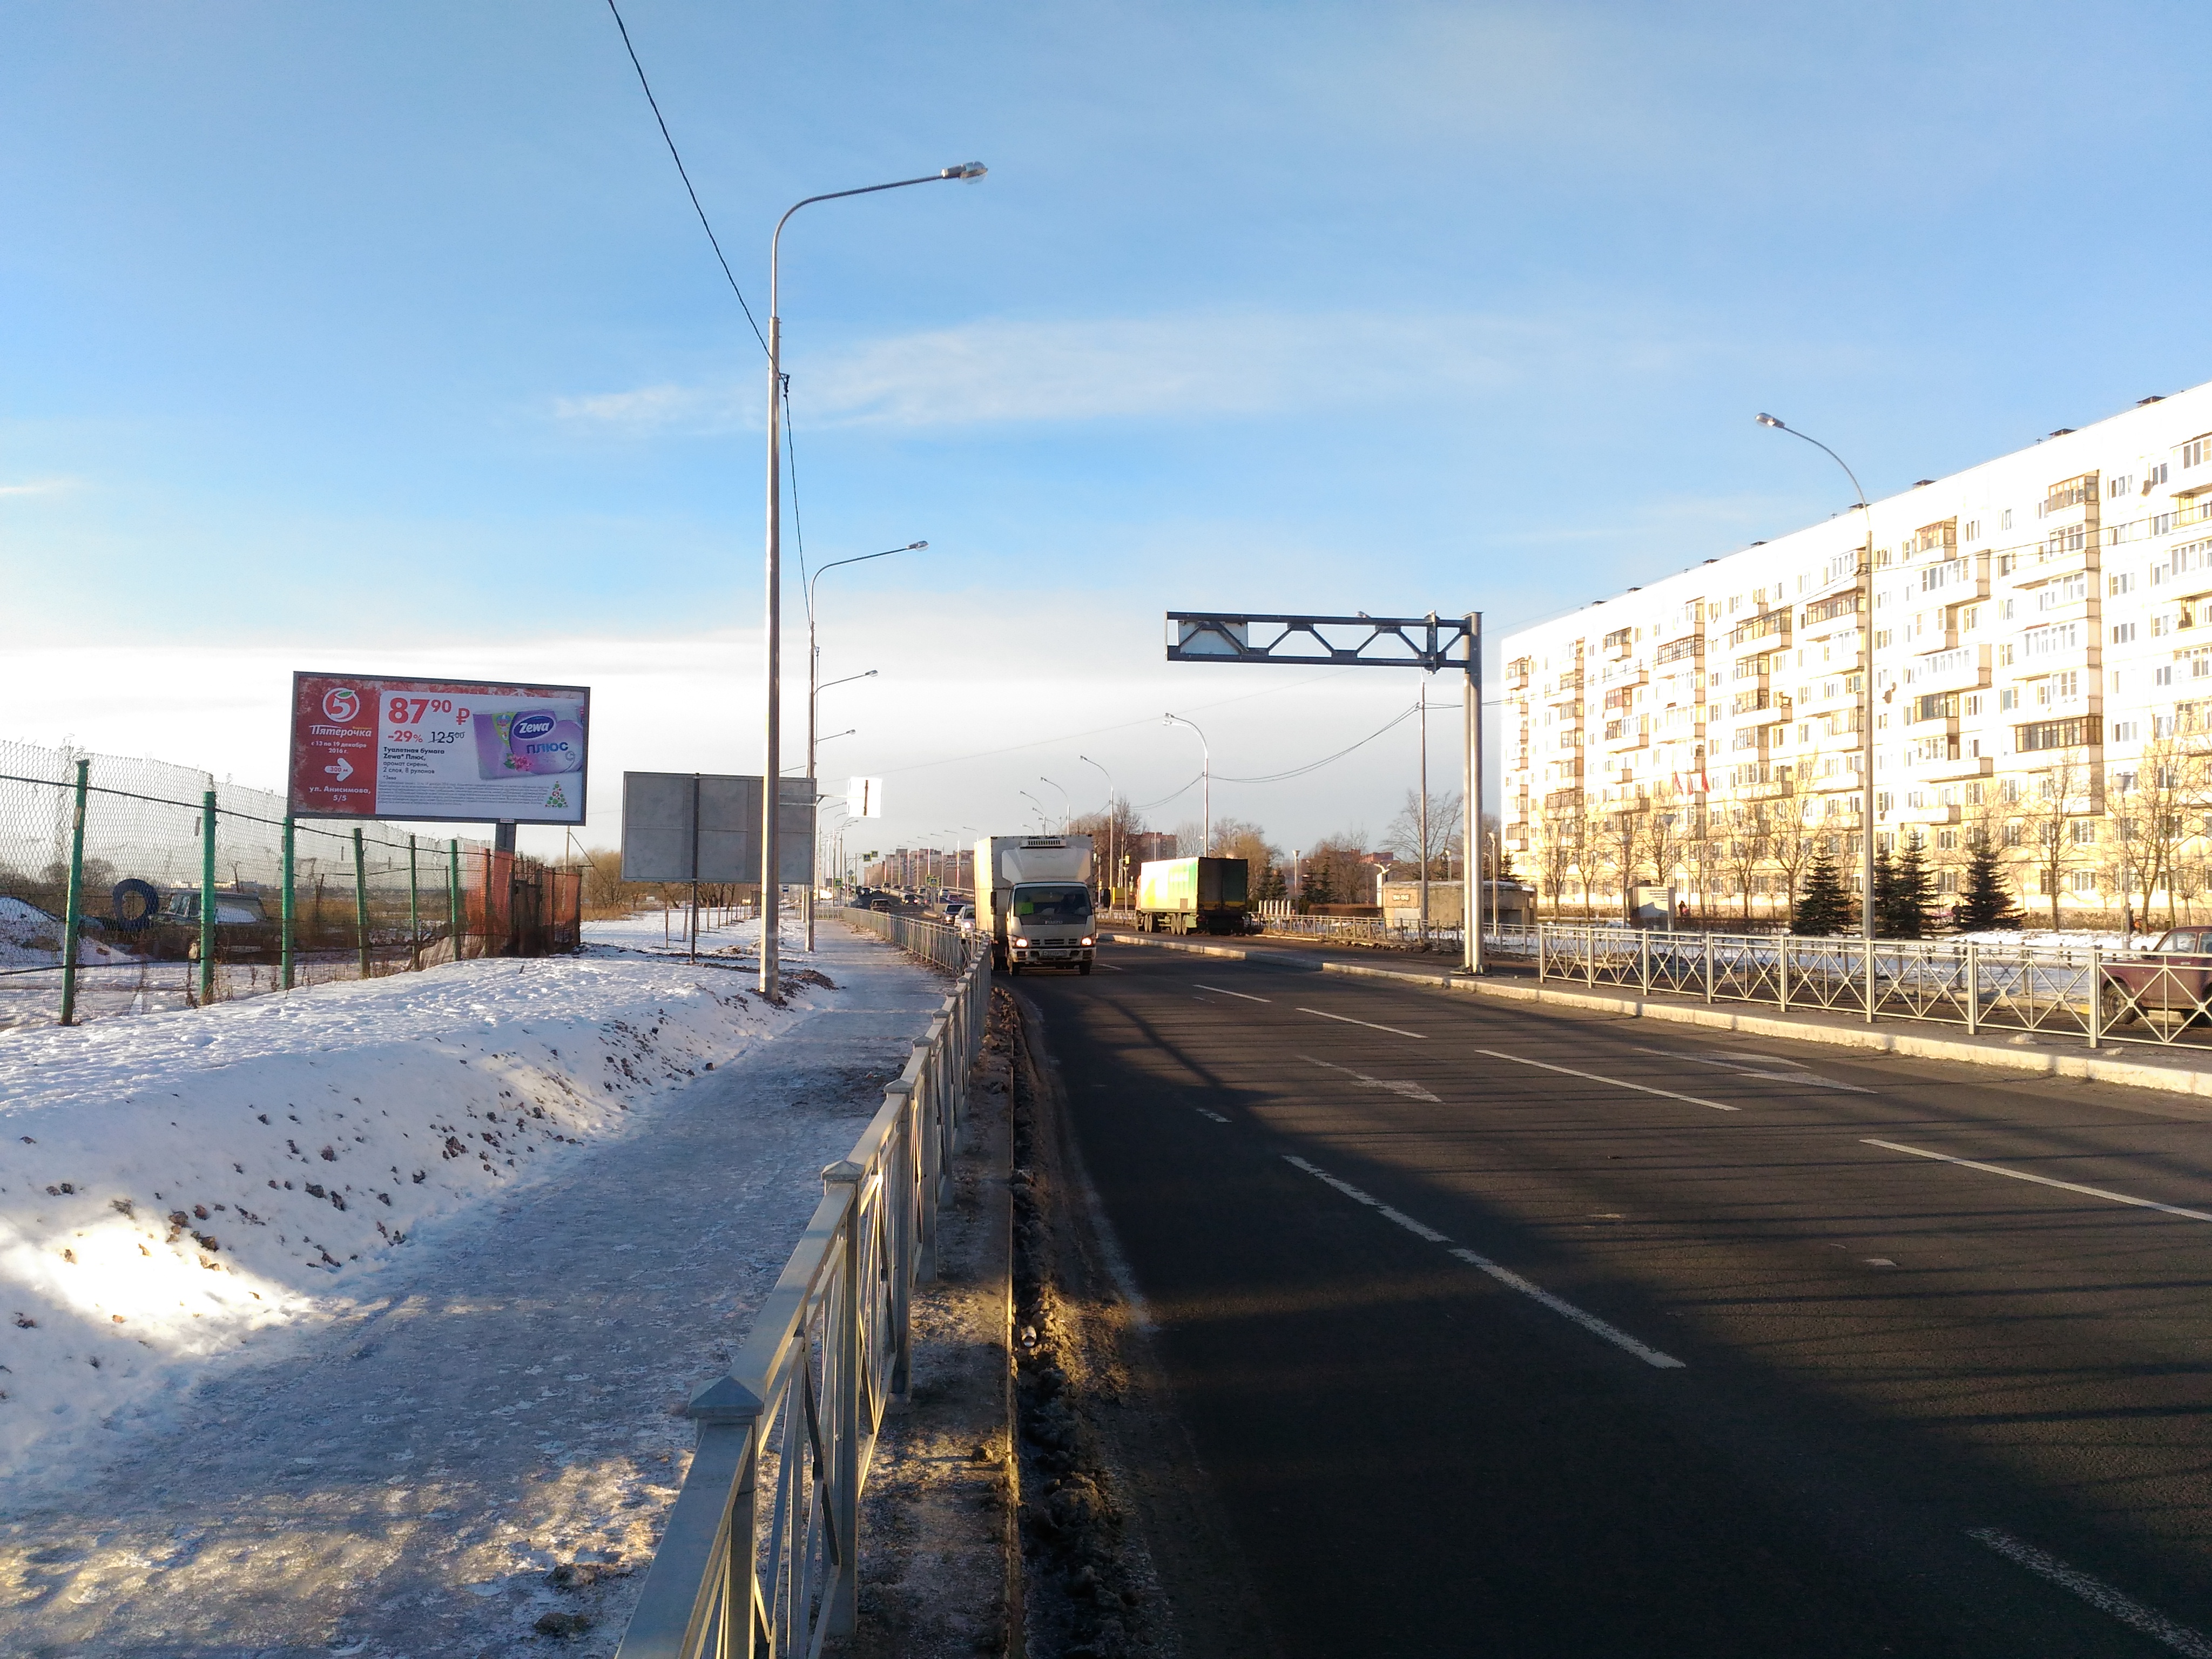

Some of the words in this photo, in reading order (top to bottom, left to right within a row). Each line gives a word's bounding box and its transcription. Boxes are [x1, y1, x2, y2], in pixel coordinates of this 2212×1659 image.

[309, 725, 372, 738] Пятерочка
[519, 721, 550, 734] Zewa
[323, 786, 372, 794] Анисимова,
[333, 794, 347, 802] 5/5
